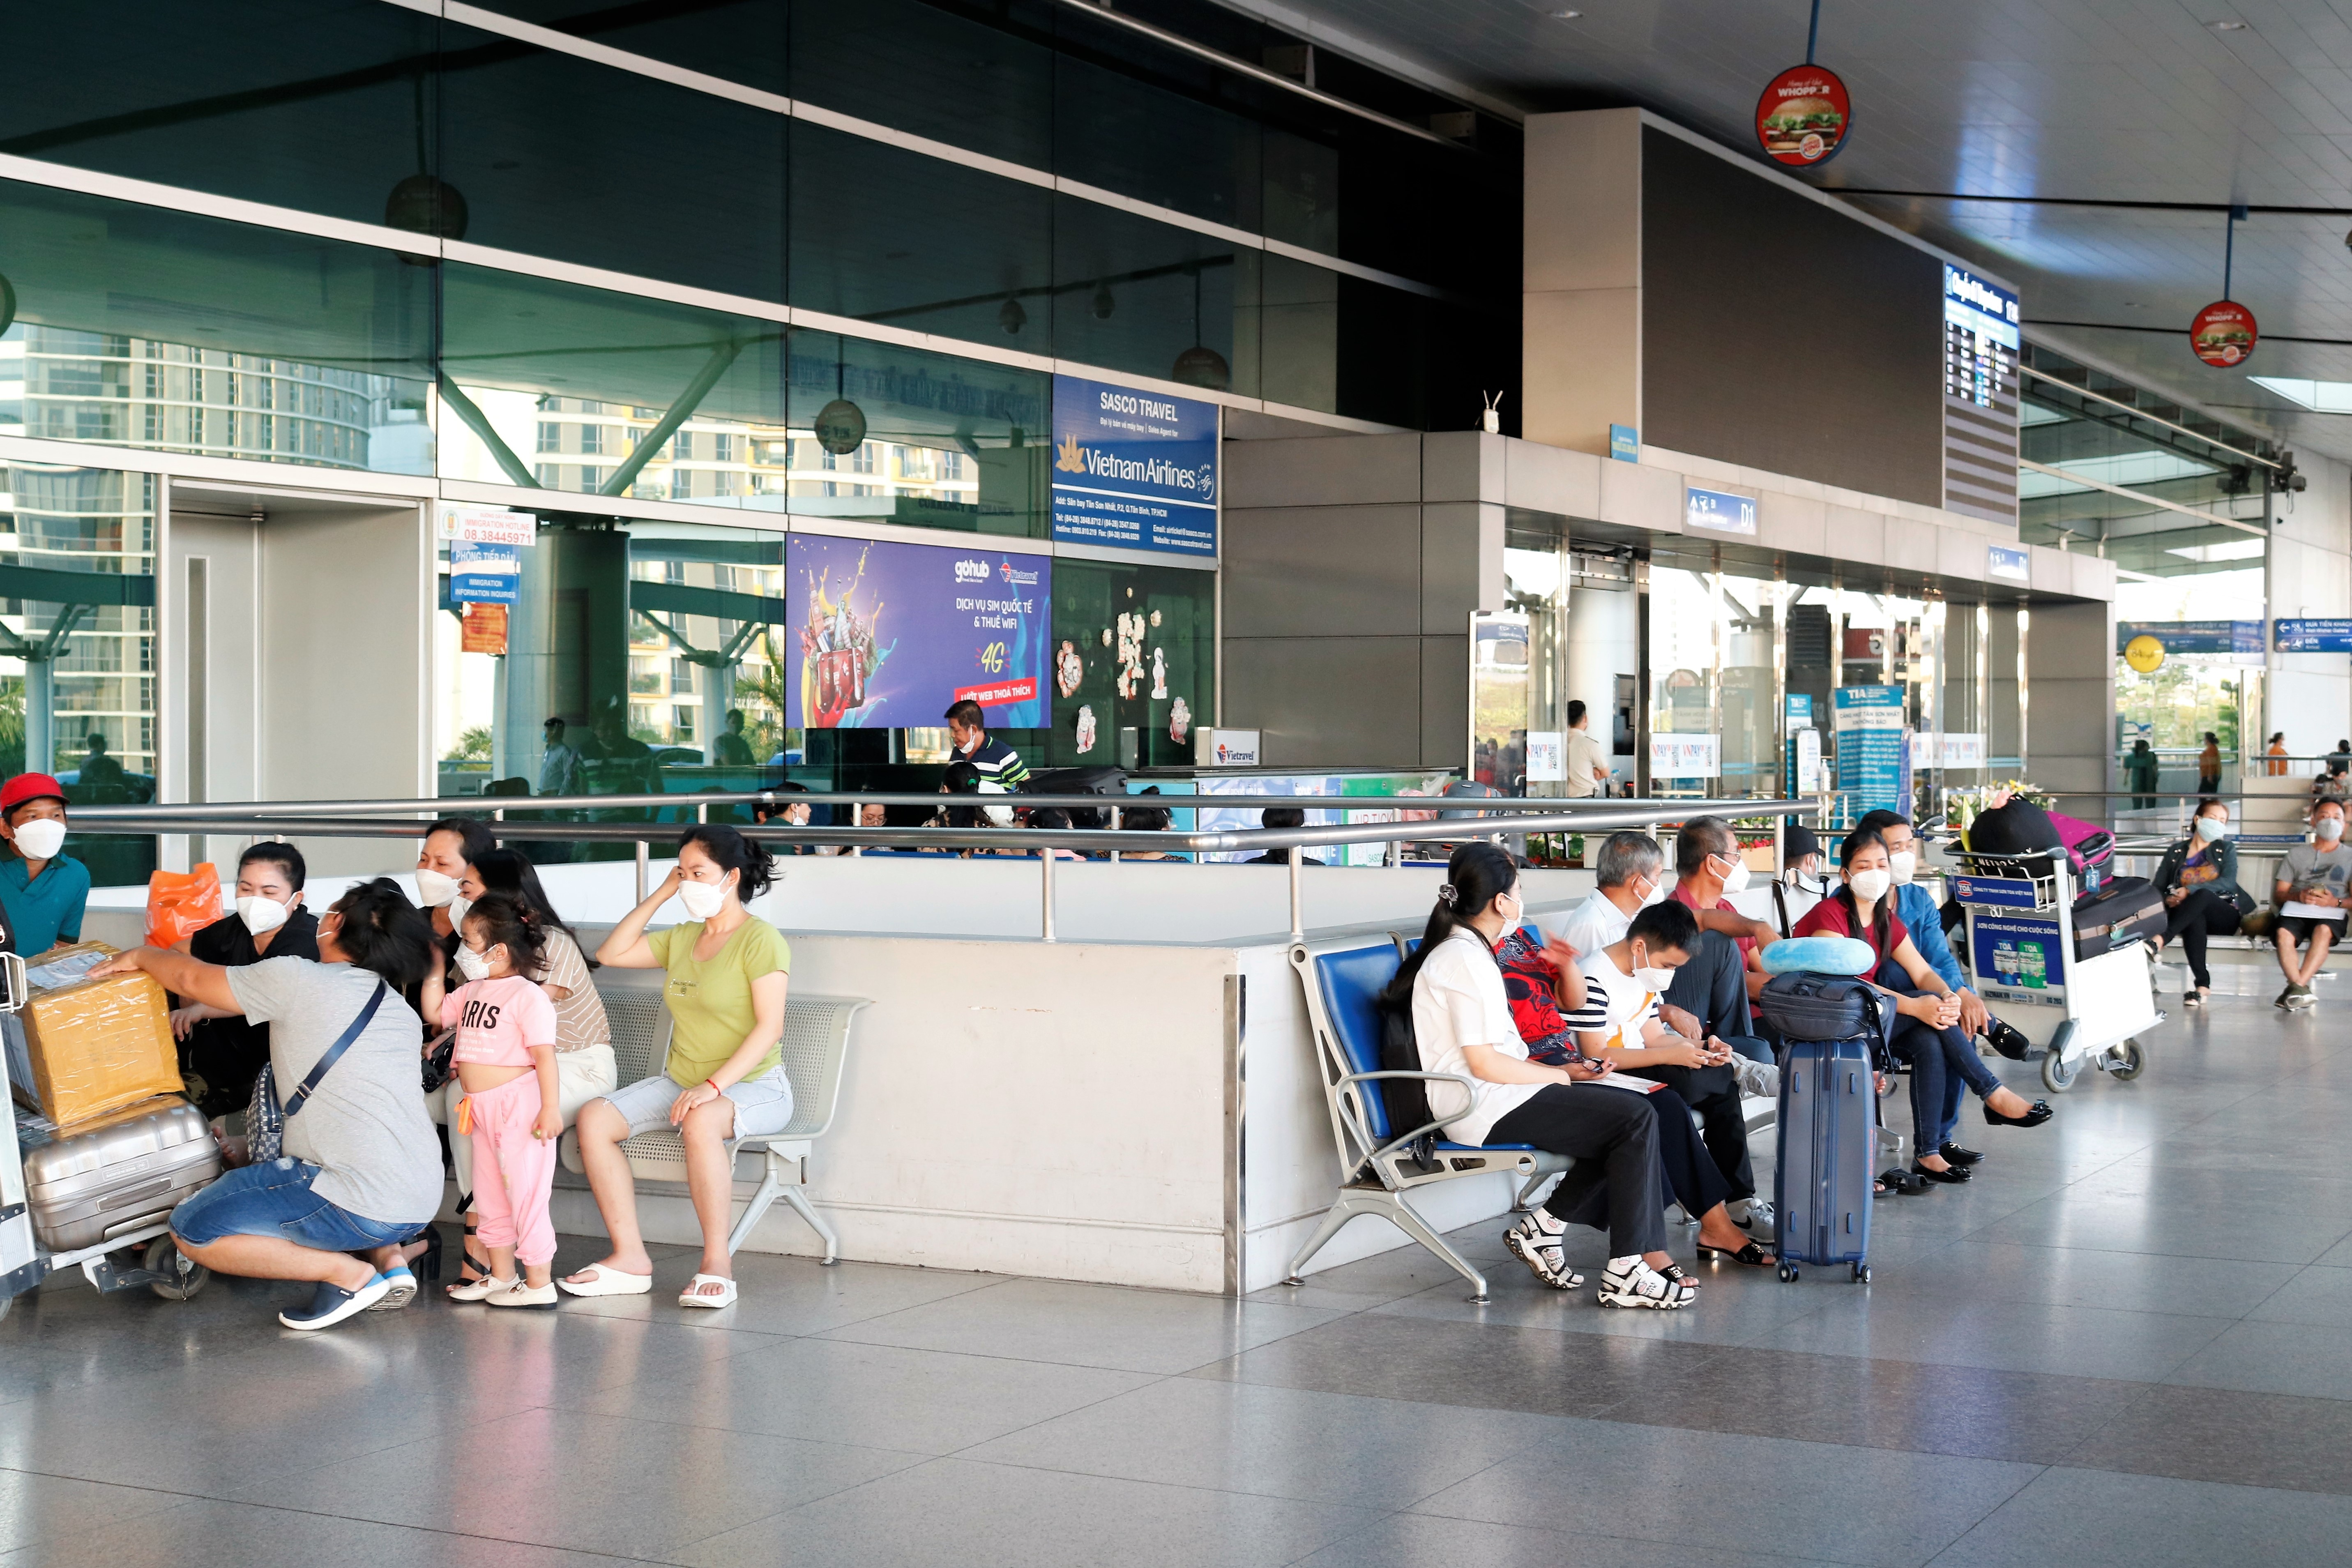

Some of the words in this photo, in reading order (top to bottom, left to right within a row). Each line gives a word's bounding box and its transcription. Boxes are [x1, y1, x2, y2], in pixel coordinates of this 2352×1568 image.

[1100, 391, 1137, 414] SASCO
[1138, 398, 1178, 422] TRAVEL
[1136, 424, 1145, 433] bay
[1160, 427, 1171, 437] Agent
[1086, 447, 1144, 483] Vietnam
[1145, 458, 1195, 490] Airlines
[1055, 496, 1066, 504] Add:
[1067, 497, 1076, 506] Sân
[1076, 499, 1085, 509] bay
[1086, 500, 1095, 509] Tân
[1151, 508, 1168, 517] TP.HCM
[1055, 513, 1064, 521] Tel:
[1741, 503, 1753, 527] D1
[465, 519, 504, 529] IMMIGRATION
[505, 522, 530, 531] HOTLINE
[1055, 525, 1071, 533] Hotline:
[1153, 524, 1166, 533] Email:
[465, 529, 531, 544] 08.38445971
[1153, 535, 1170, 544] Website:
[469, 578, 503, 587] IMMIGRATION
[455, 588, 490, 597] INFORMATION
[491, 590, 516, 599] INQUIRIES
[956, 597, 973, 611] DỊCH
[975, 599, 986, 612] VỤ
[987, 600, 1000, 611] SIM
[1001, 598, 1022, 615] QUỐC
[1023, 599, 1033, 613] TẾ
[974, 616, 980, 627] &
[981, 615, 1001, 629] THUÊ
[1002, 618, 1017, 629] WIFI
[981, 642, 1005, 673] 4G
[978, 691, 993, 701] WEB
[1012, 684, 1031, 697] THÍCH
[1847, 689, 1866, 699] TIA
[1227, 750, 1254, 760] Vietravel
[1526, 744, 1542, 758] NPAY
[2002, 924, 2017, 933] NGHỆ
[2028, 926, 2043, 935] CUỘC
[2043, 927, 2059, 935] SỐNG
[1998, 942, 2012, 951] TOA
[2024, 944, 2038, 953] TOA
